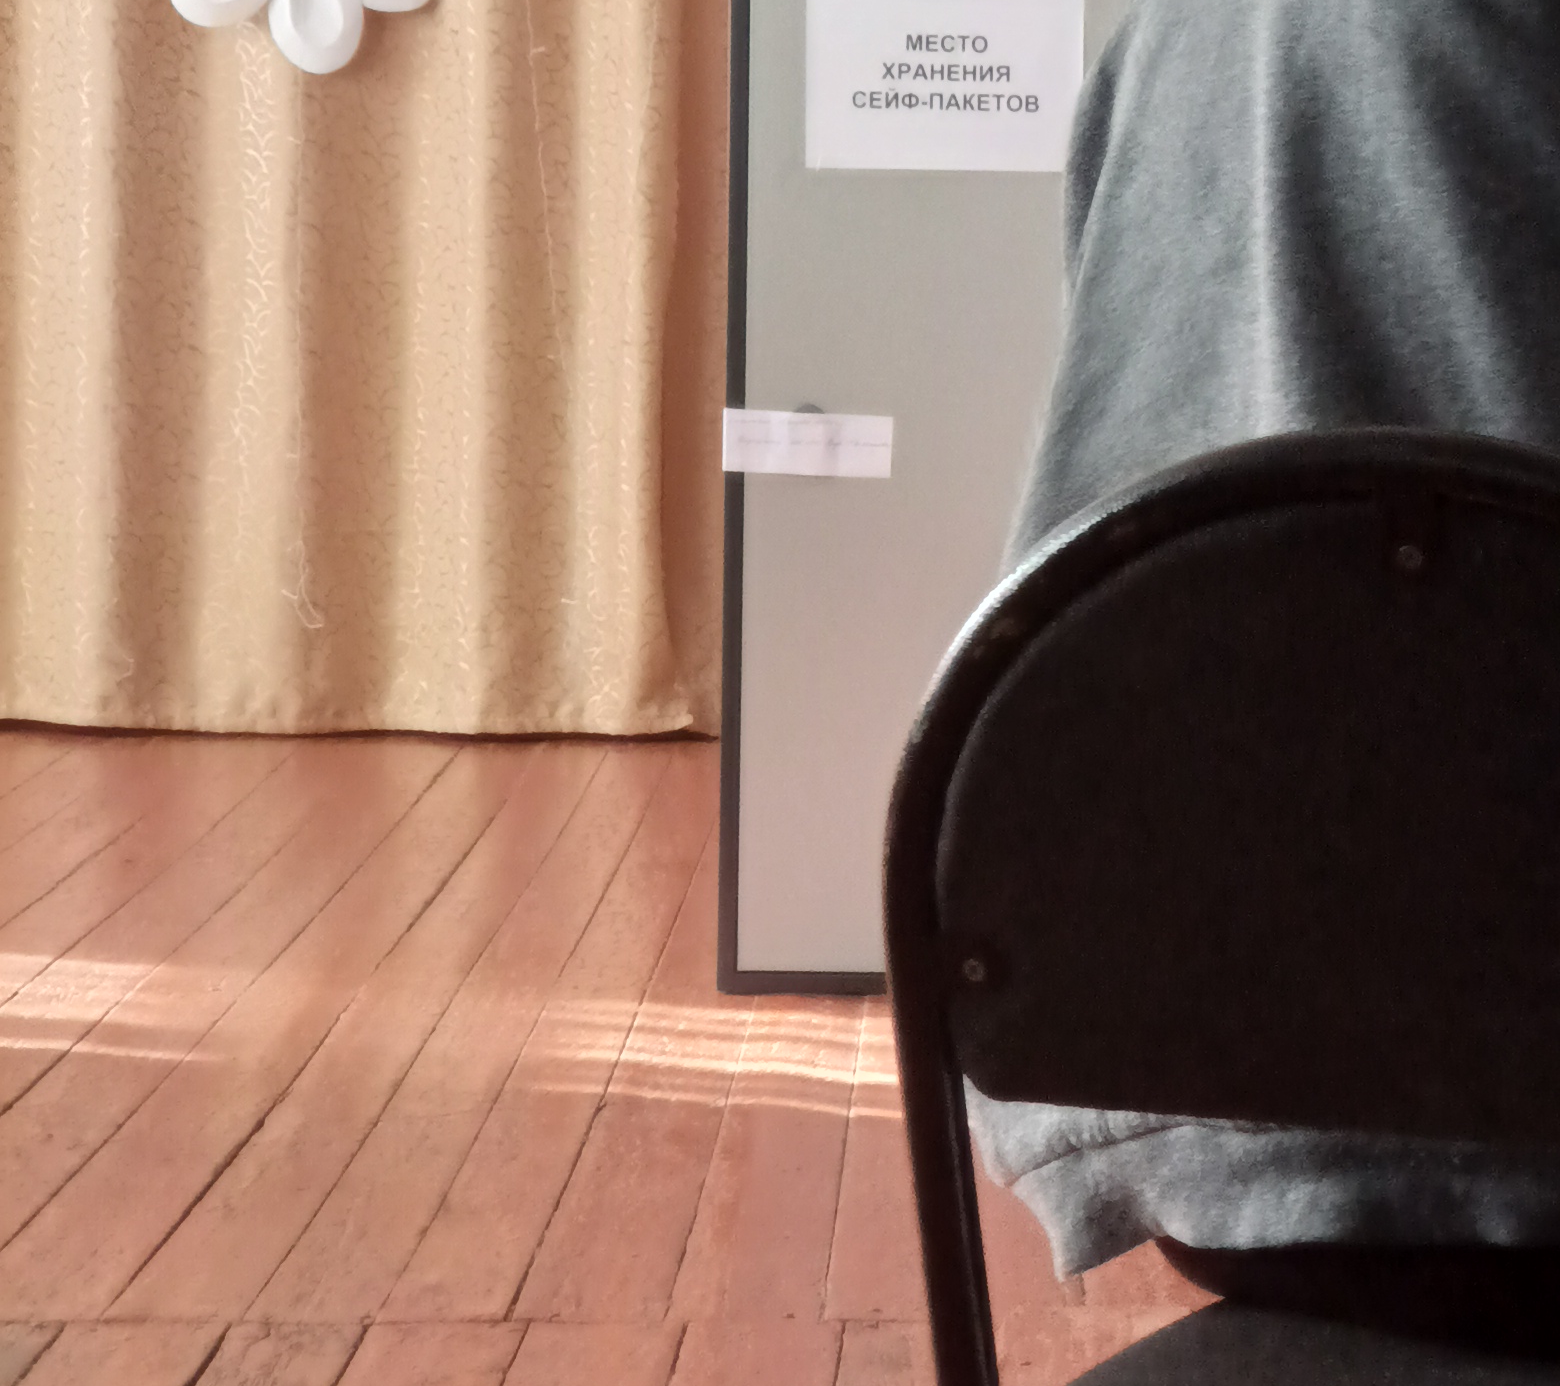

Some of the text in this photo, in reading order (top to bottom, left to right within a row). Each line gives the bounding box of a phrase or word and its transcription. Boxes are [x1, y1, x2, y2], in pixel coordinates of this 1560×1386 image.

[905, 34, 988, 53] МЕСТО
[882, 62, 1011, 82] ХРАНЕНИЯ
[852, 88, 1040, 113] СЕЙФ-ПАКЕТОВ
